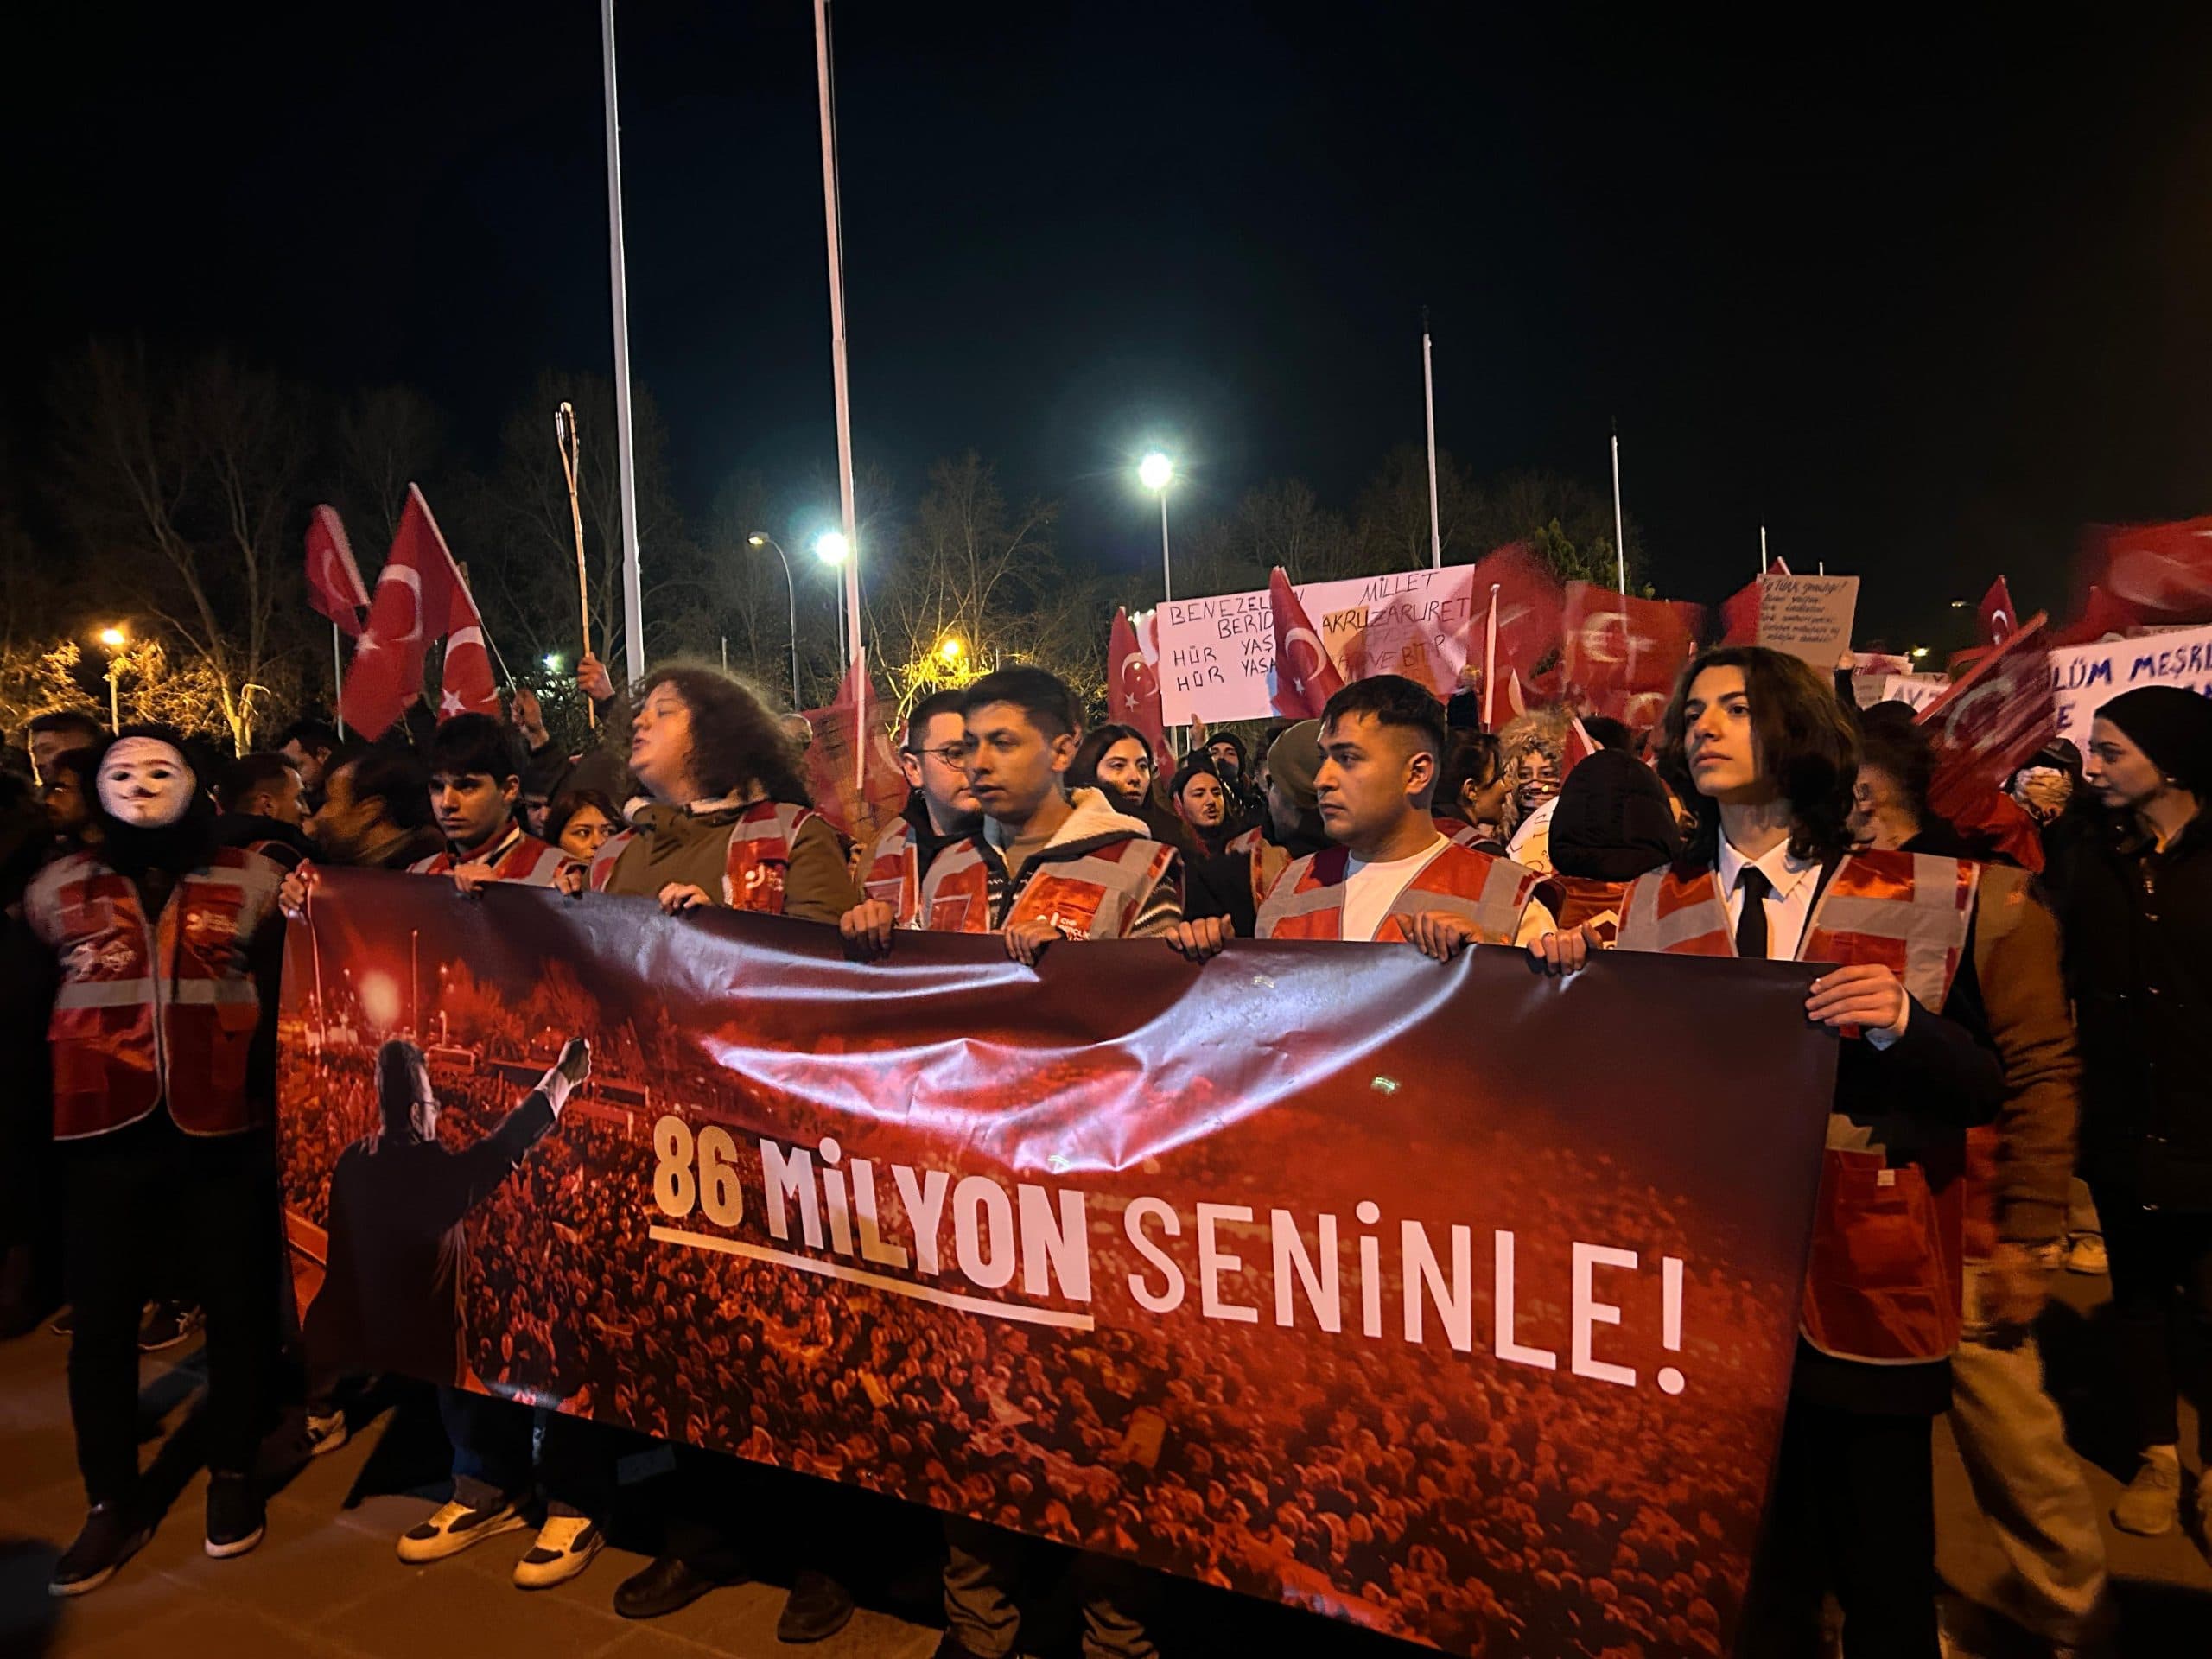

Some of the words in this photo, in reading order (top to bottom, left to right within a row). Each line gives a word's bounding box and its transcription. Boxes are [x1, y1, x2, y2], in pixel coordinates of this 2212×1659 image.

[1217, 611, 1275, 639] BERİD
[1173, 645, 1217, 666] HÜR
[1177, 666, 1224, 691] HÜR
[2052, 657, 2113, 691] LÜM
[652, 1115, 744, 1227] 86
